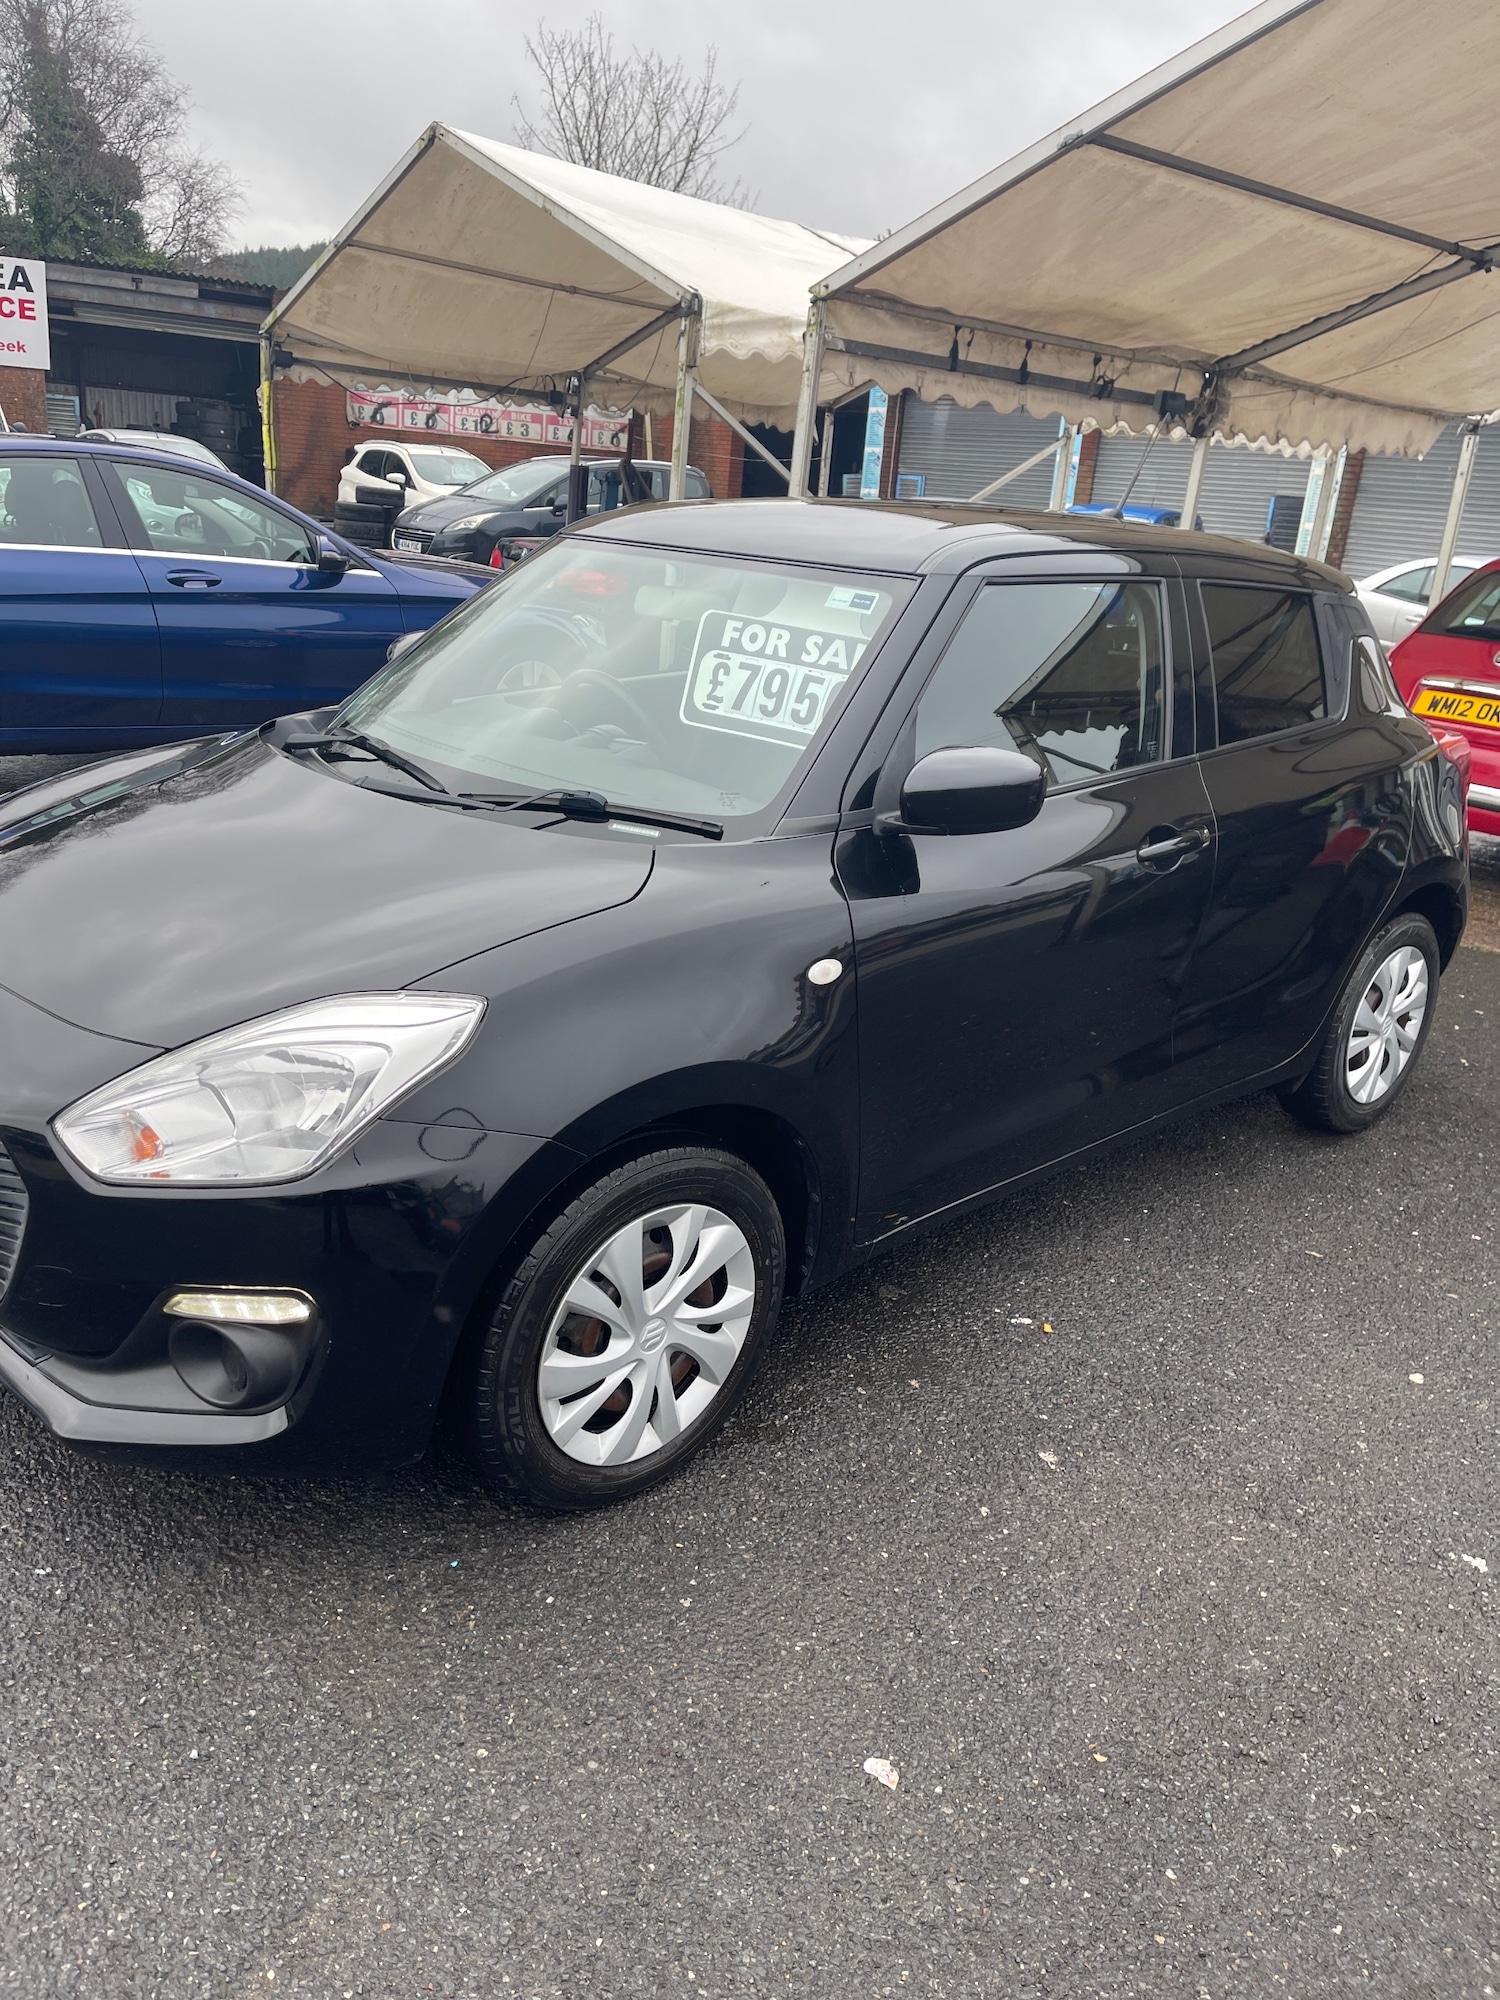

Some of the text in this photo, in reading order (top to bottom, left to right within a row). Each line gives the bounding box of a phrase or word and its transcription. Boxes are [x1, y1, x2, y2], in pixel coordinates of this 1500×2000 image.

[455, 406, 498, 418] CARAVAN
[511, 412, 532, 422] BIKE
[720, 619, 791, 658] FOR
[1426, 695, 1474, 717] WM12
